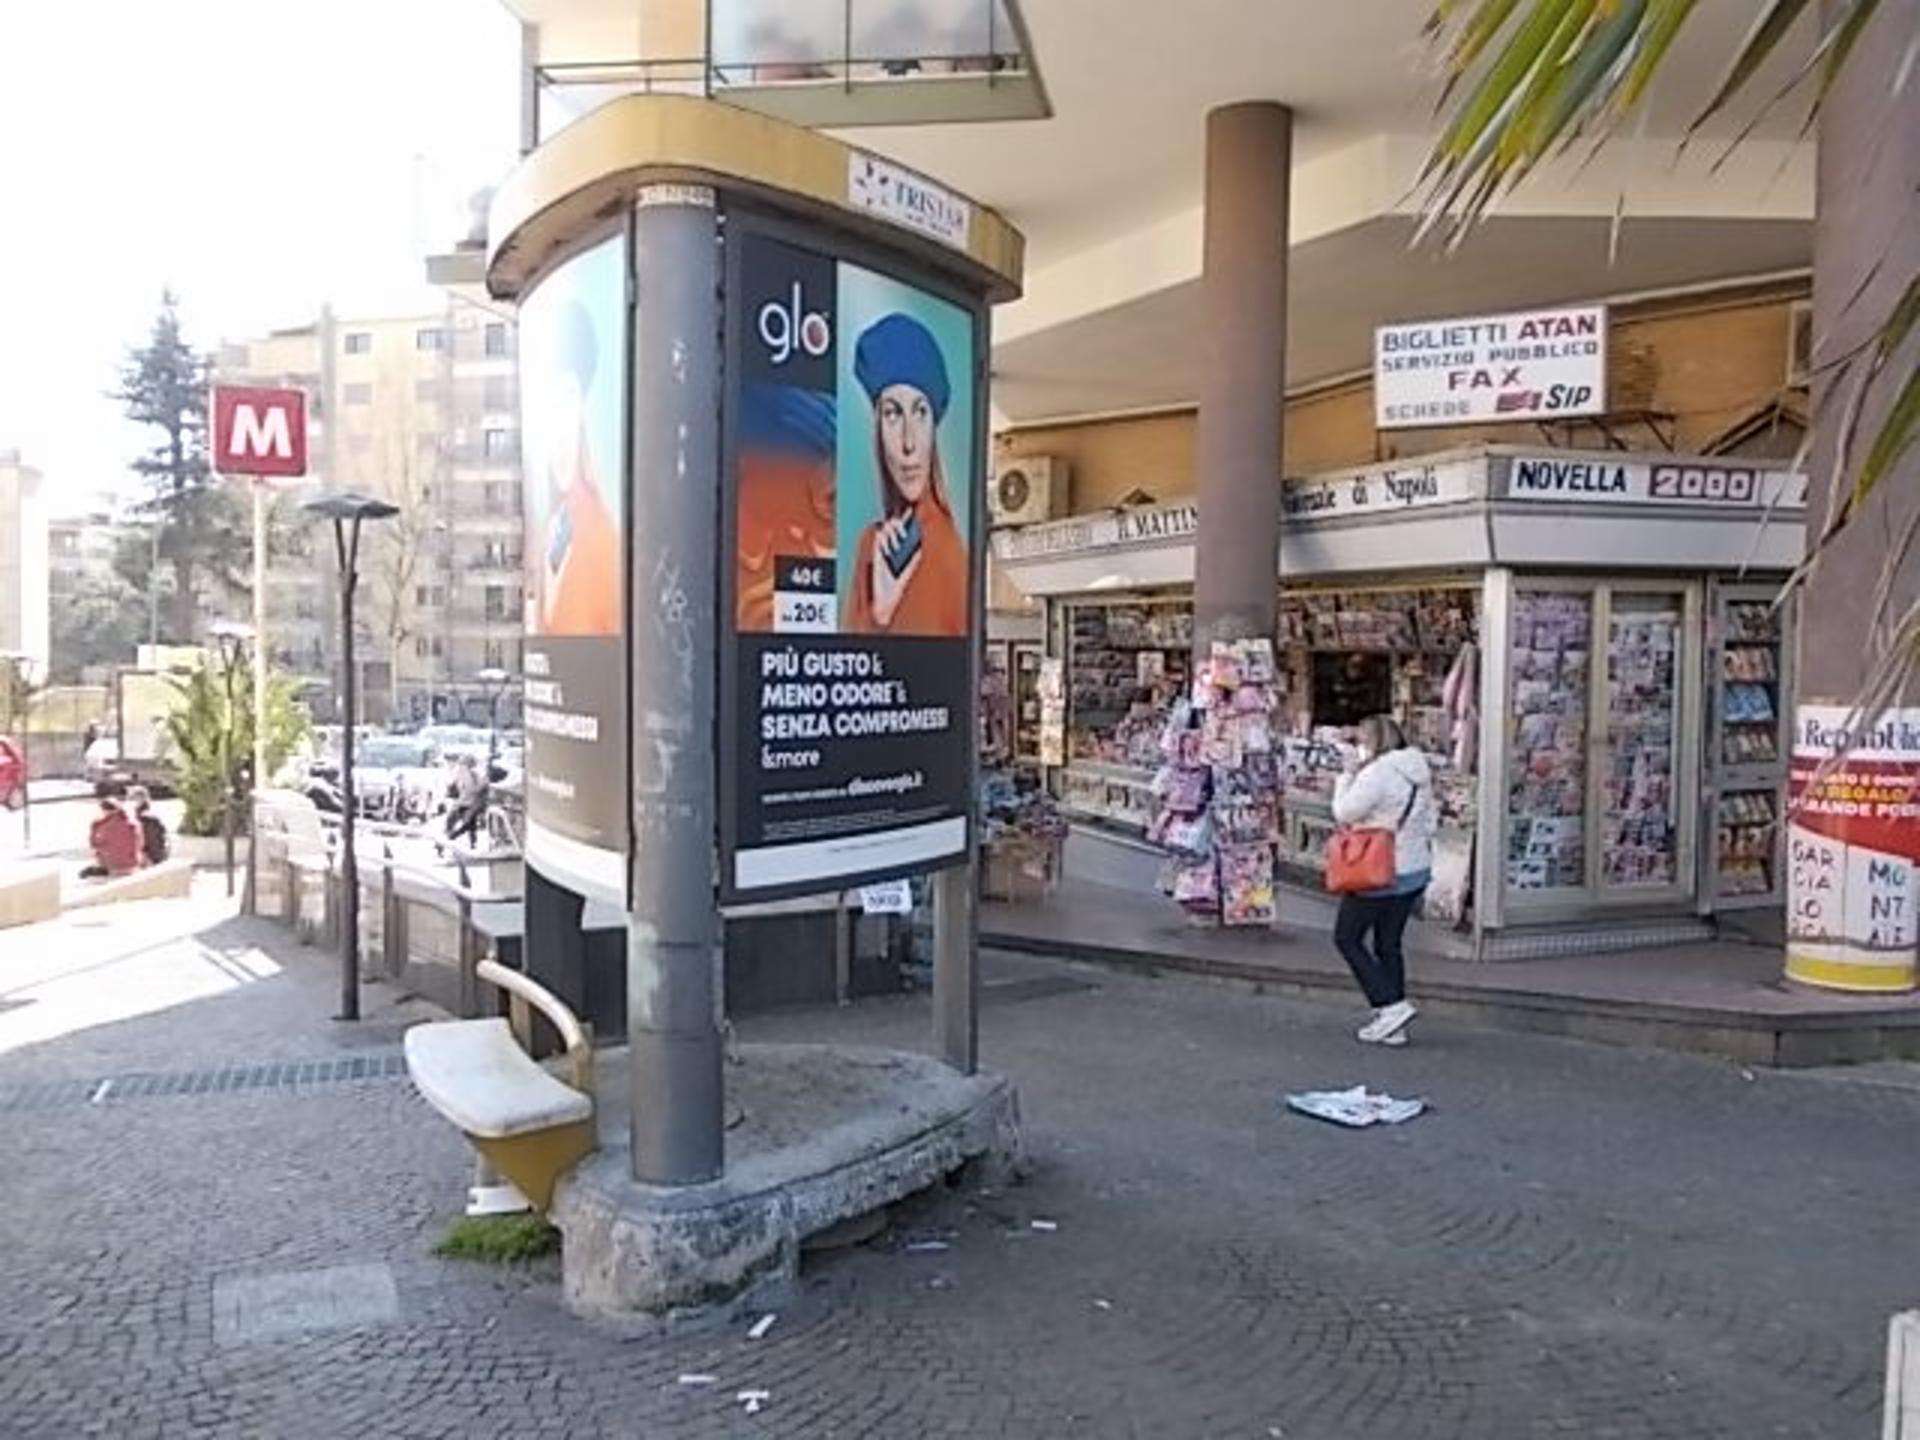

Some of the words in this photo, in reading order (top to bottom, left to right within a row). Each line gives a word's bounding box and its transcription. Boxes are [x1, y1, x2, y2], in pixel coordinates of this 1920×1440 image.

[759, 281, 829, 363] glo
[1383, 324, 1507, 352] BIGLIETTI
[1518, 314, 1597, 340] ATAN
[1382, 350, 1474, 373] SERVIZIO
[1488, 340, 1599, 363] PUBBLICO
[1448, 365, 1522, 391] FAX
[1385, 400, 1472, 421] SCHEDE
[1545, 383, 1593, 409] SIP
[229, 404, 293, 457] M
[1384, 464, 1439, 505] Napoli
[1516, 460, 1627, 494] NOVELLA
[1654, 466, 1752, 500] 2000
[761, 647, 799, 677] PIÙ
[803, 652, 870, 677] GUSTO
[762, 682, 828, 708] MENO
[762, 713, 831, 740] SENZA
[834, 706, 950, 736] COMPROMESSI
